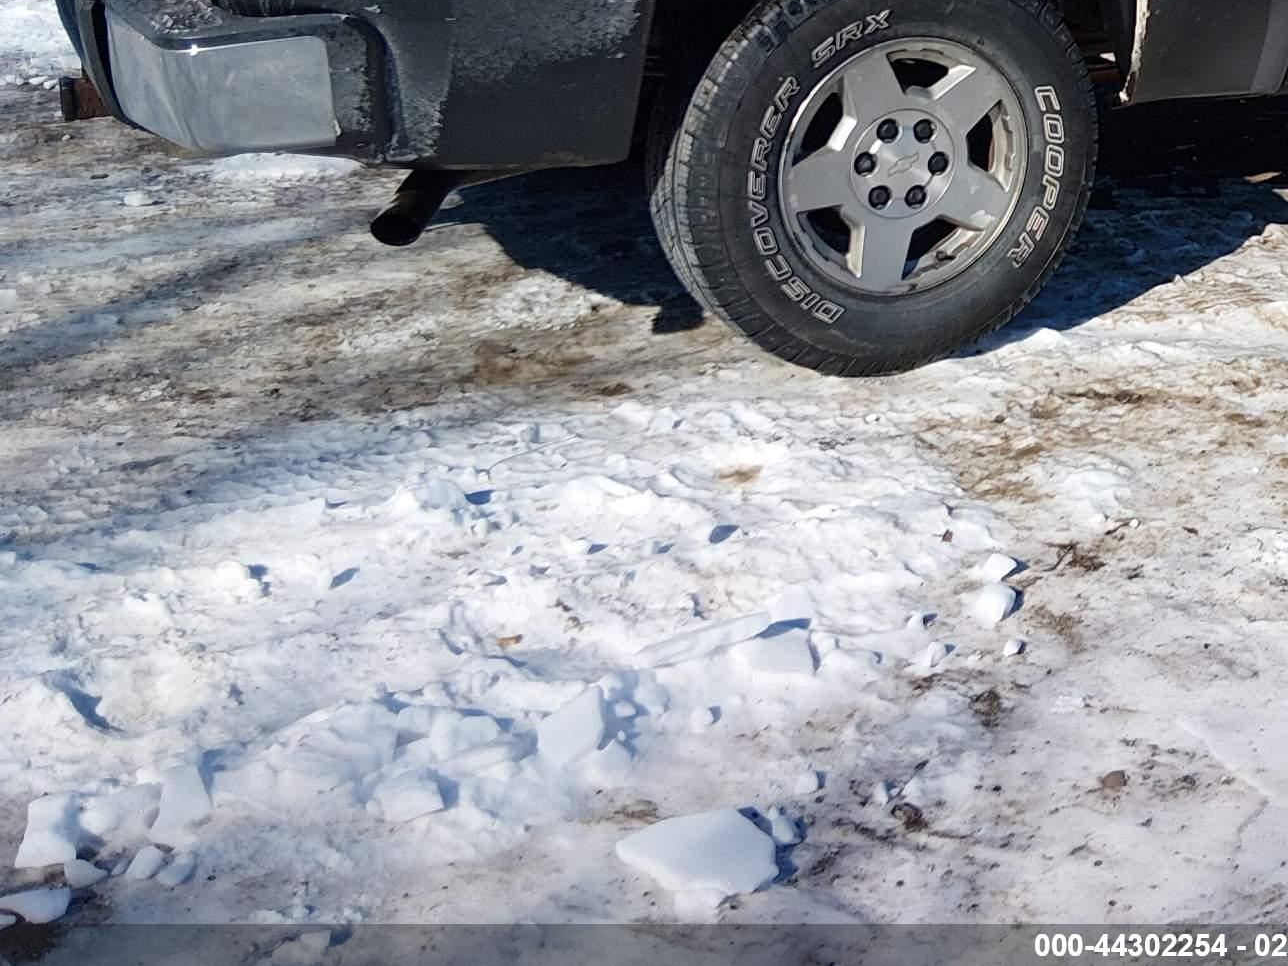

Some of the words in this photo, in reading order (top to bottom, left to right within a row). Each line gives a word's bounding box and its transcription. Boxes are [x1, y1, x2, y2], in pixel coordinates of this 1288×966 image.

[746, 75, 846, 325] DISCOVERER
[809, 9, 892, 69] SRX
[1007, 84, 1066, 268] COOPER
